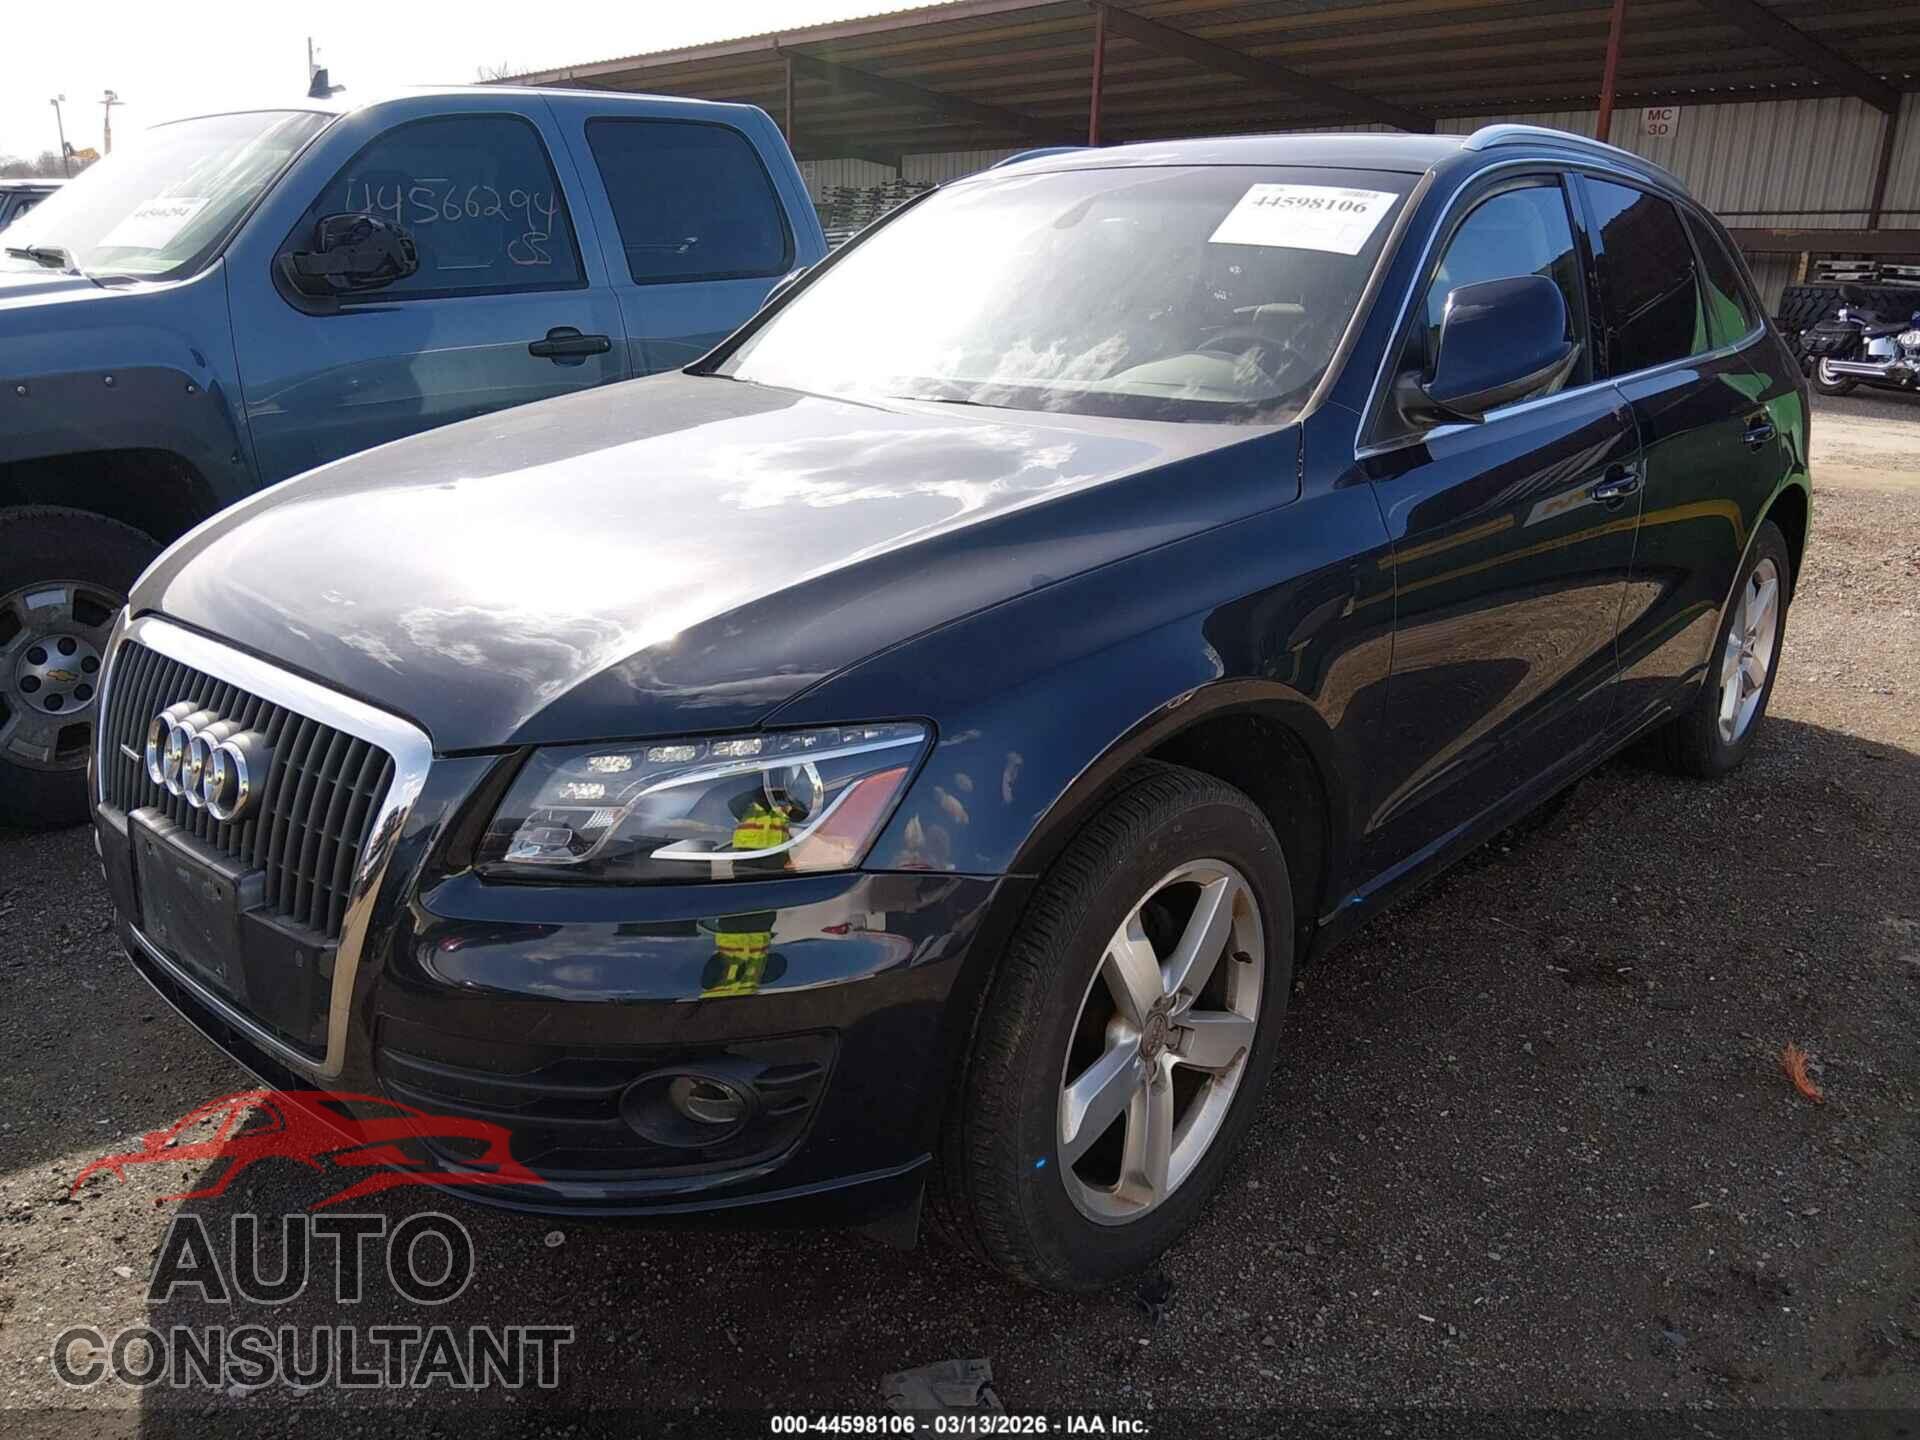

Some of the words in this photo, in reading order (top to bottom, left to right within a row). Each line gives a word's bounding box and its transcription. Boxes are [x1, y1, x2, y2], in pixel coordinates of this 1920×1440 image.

[1648, 108, 1673, 121] MC
[1647, 123, 1668, 136] 30
[1251, 195, 1368, 214] 44598106
